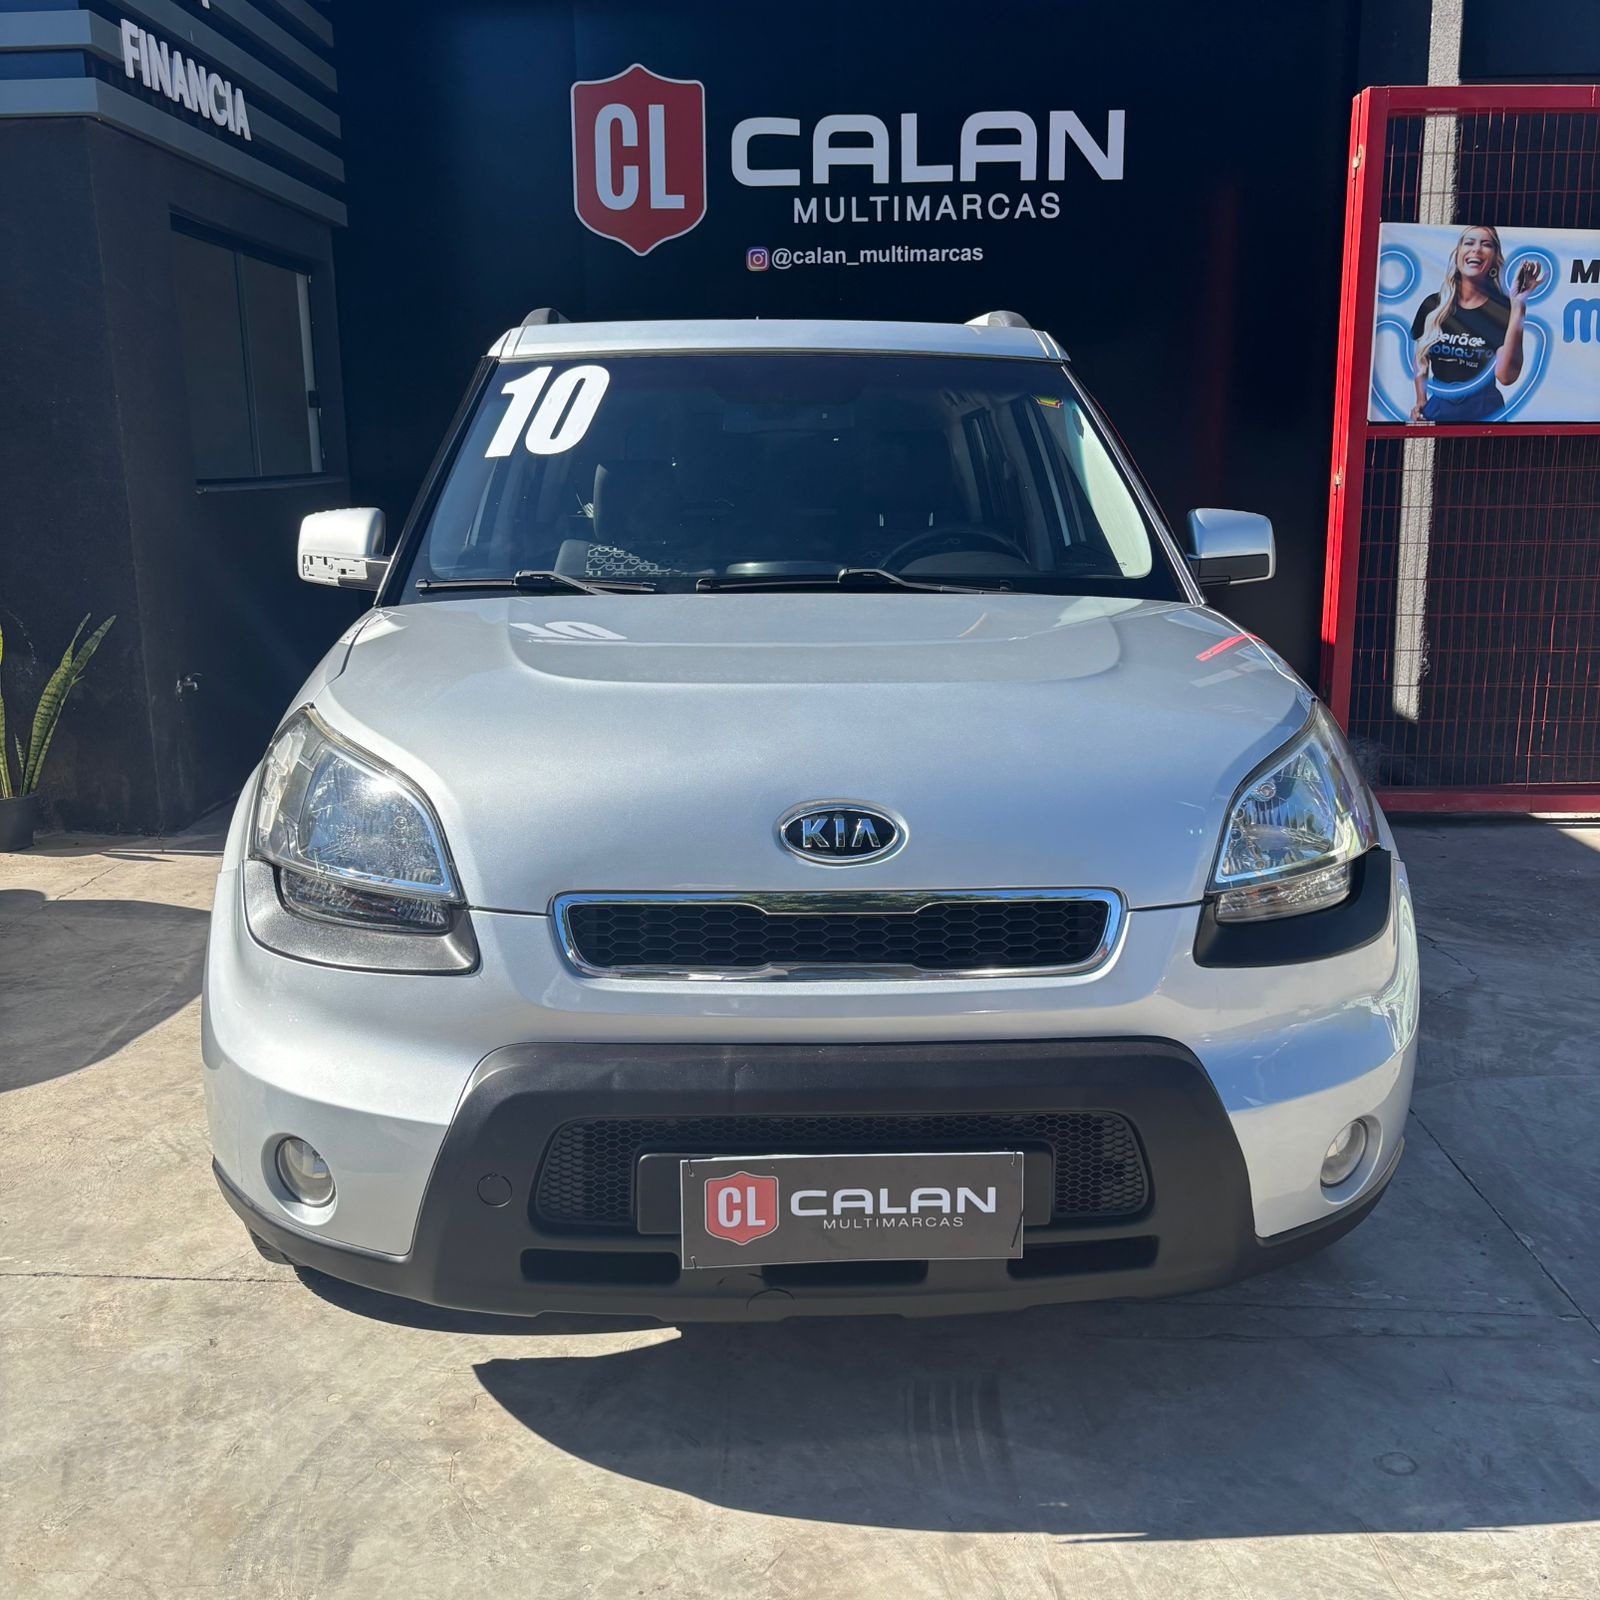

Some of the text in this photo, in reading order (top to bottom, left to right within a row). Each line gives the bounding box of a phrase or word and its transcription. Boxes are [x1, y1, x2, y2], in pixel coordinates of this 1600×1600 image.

[120, 18, 252, 141] FINANCIA
[595, 103, 686, 211] CL
[731, 109, 1126, 187] CALAN
[794, 192, 1061, 224] MULTIMARCAS
[771, 245, 984, 270] @calan_multimarcas
[485, 365, 610, 458] 10
[800, 817, 881, 848] KIA
[717, 1186, 766, 1228] CL
[790, 1186, 996, 1216] CALAN
[823, 1216, 964, 1230] MULTIMARCAS
